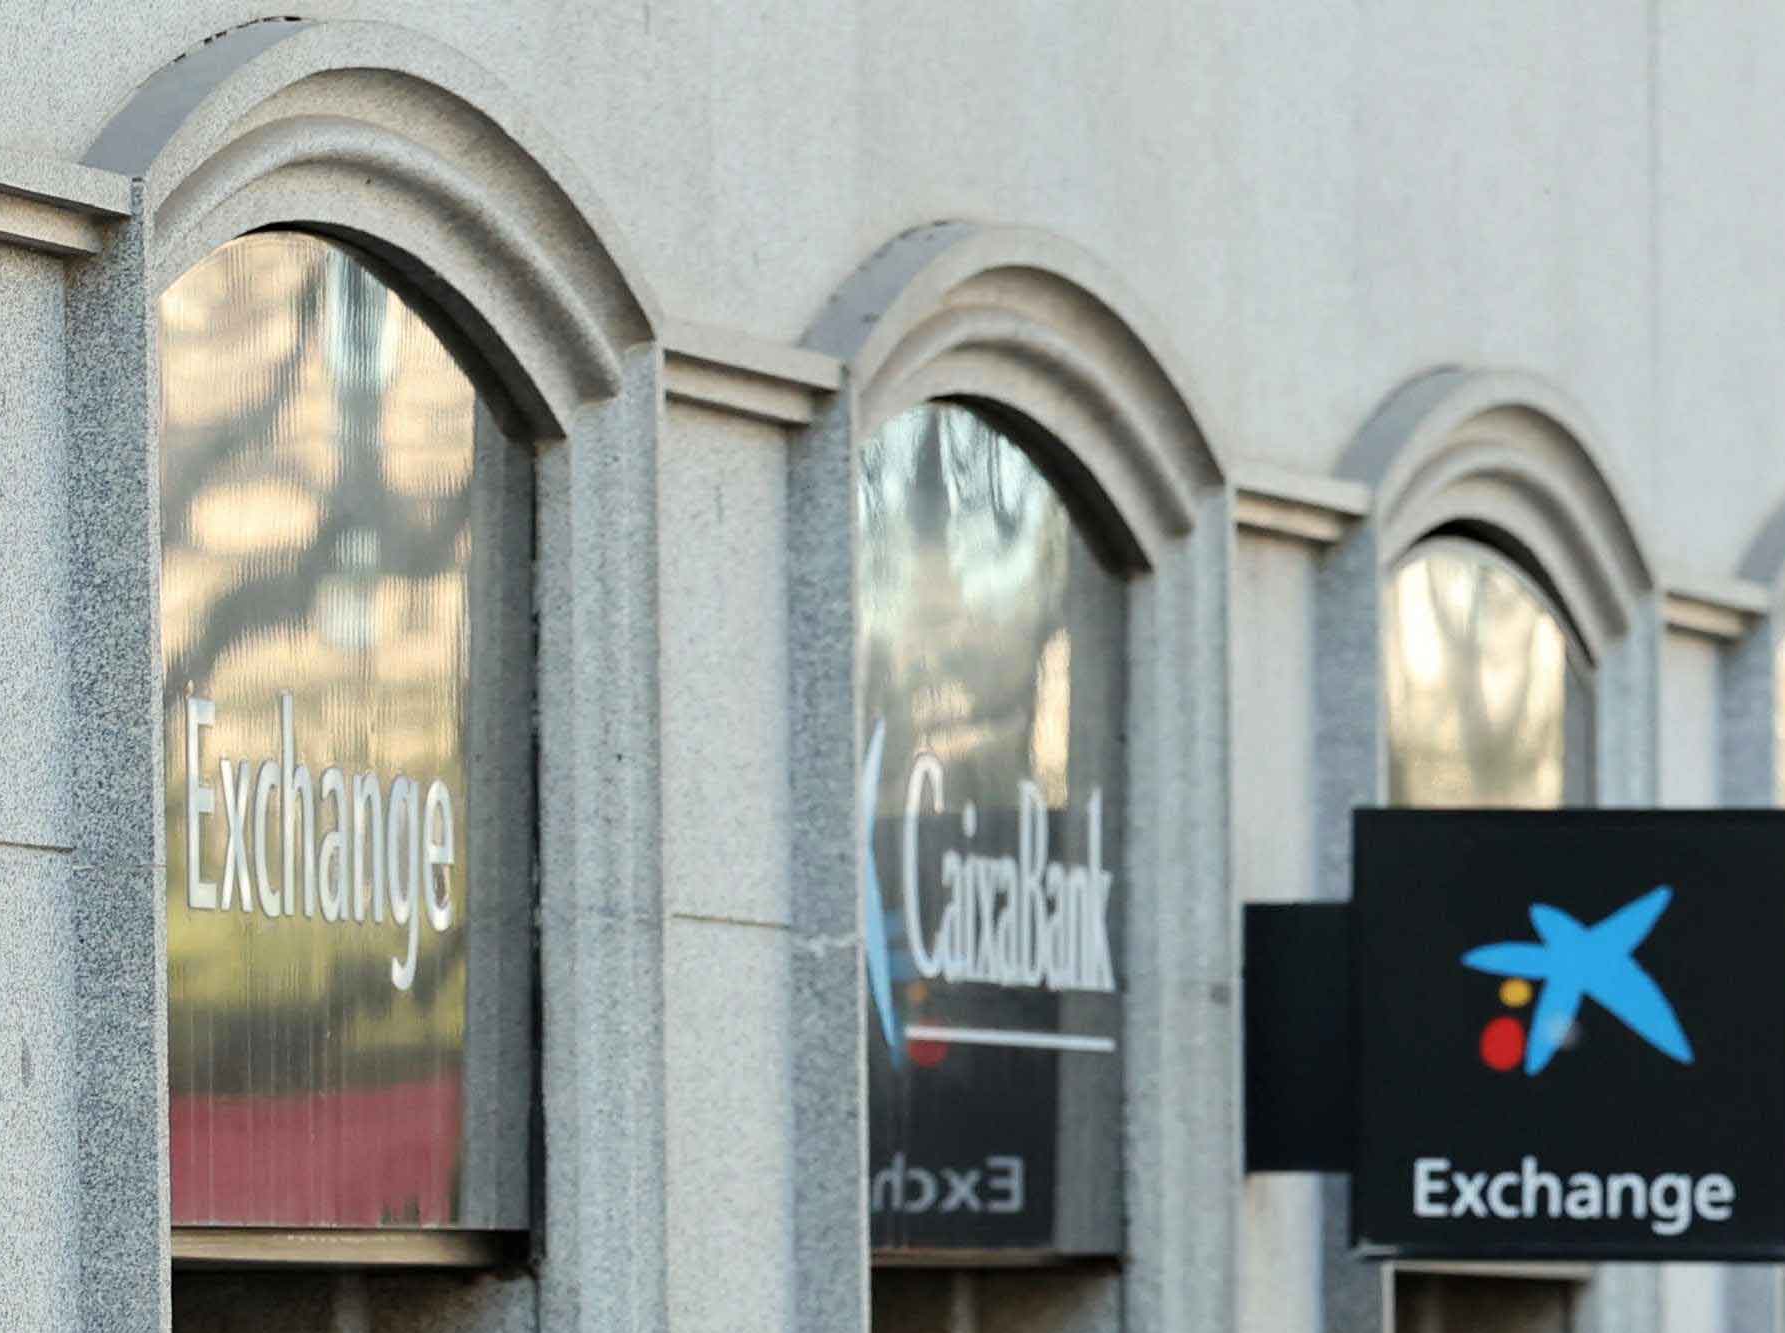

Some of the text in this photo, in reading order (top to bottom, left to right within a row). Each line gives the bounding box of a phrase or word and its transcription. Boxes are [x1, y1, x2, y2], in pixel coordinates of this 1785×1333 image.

[187, 689, 455, 991] Exchange
[903, 753, 1116, 992] CaixaBank
[1413, 1155, 1736, 1236] Exchange
